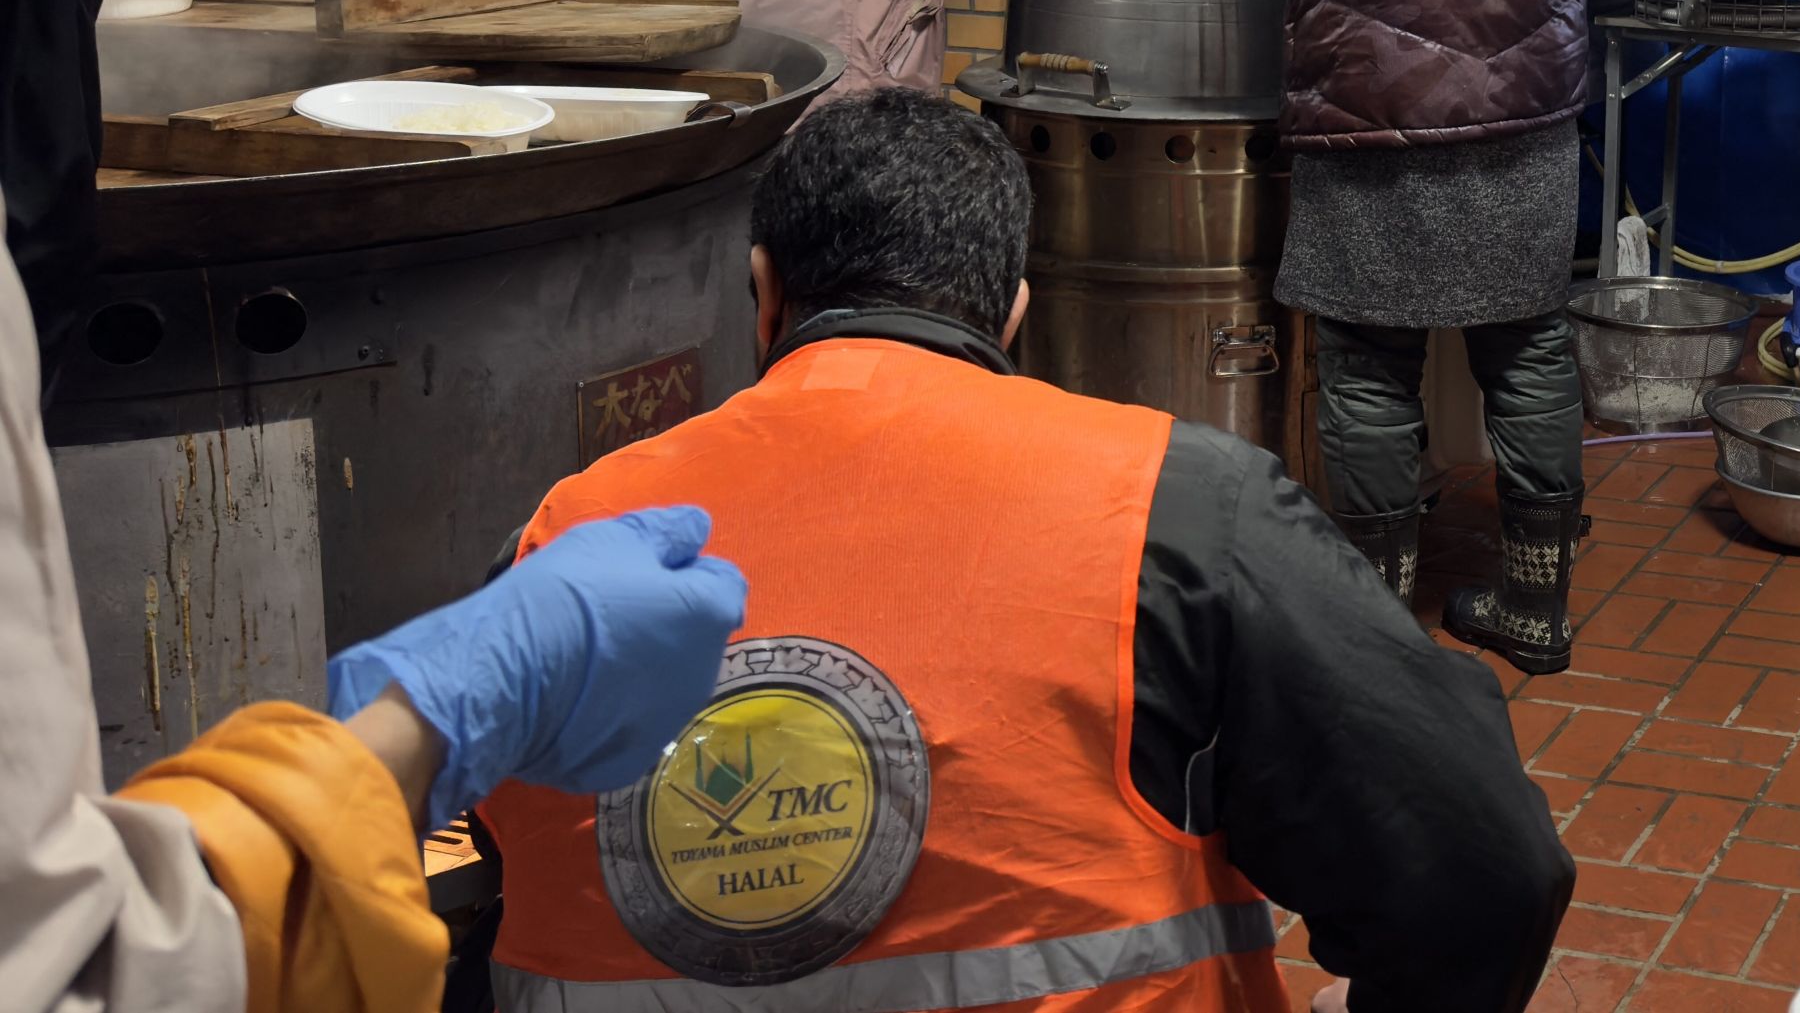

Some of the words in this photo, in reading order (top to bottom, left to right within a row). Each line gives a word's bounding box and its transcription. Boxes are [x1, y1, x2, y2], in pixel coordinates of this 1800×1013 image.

[767, 779, 853, 823] TMC
[671, 844, 726, 864] TOYAMA
[729, 835, 791, 855] MUSLIM
[791, 826, 853, 845] CENTER
[717, 863, 805, 896] HALAL
